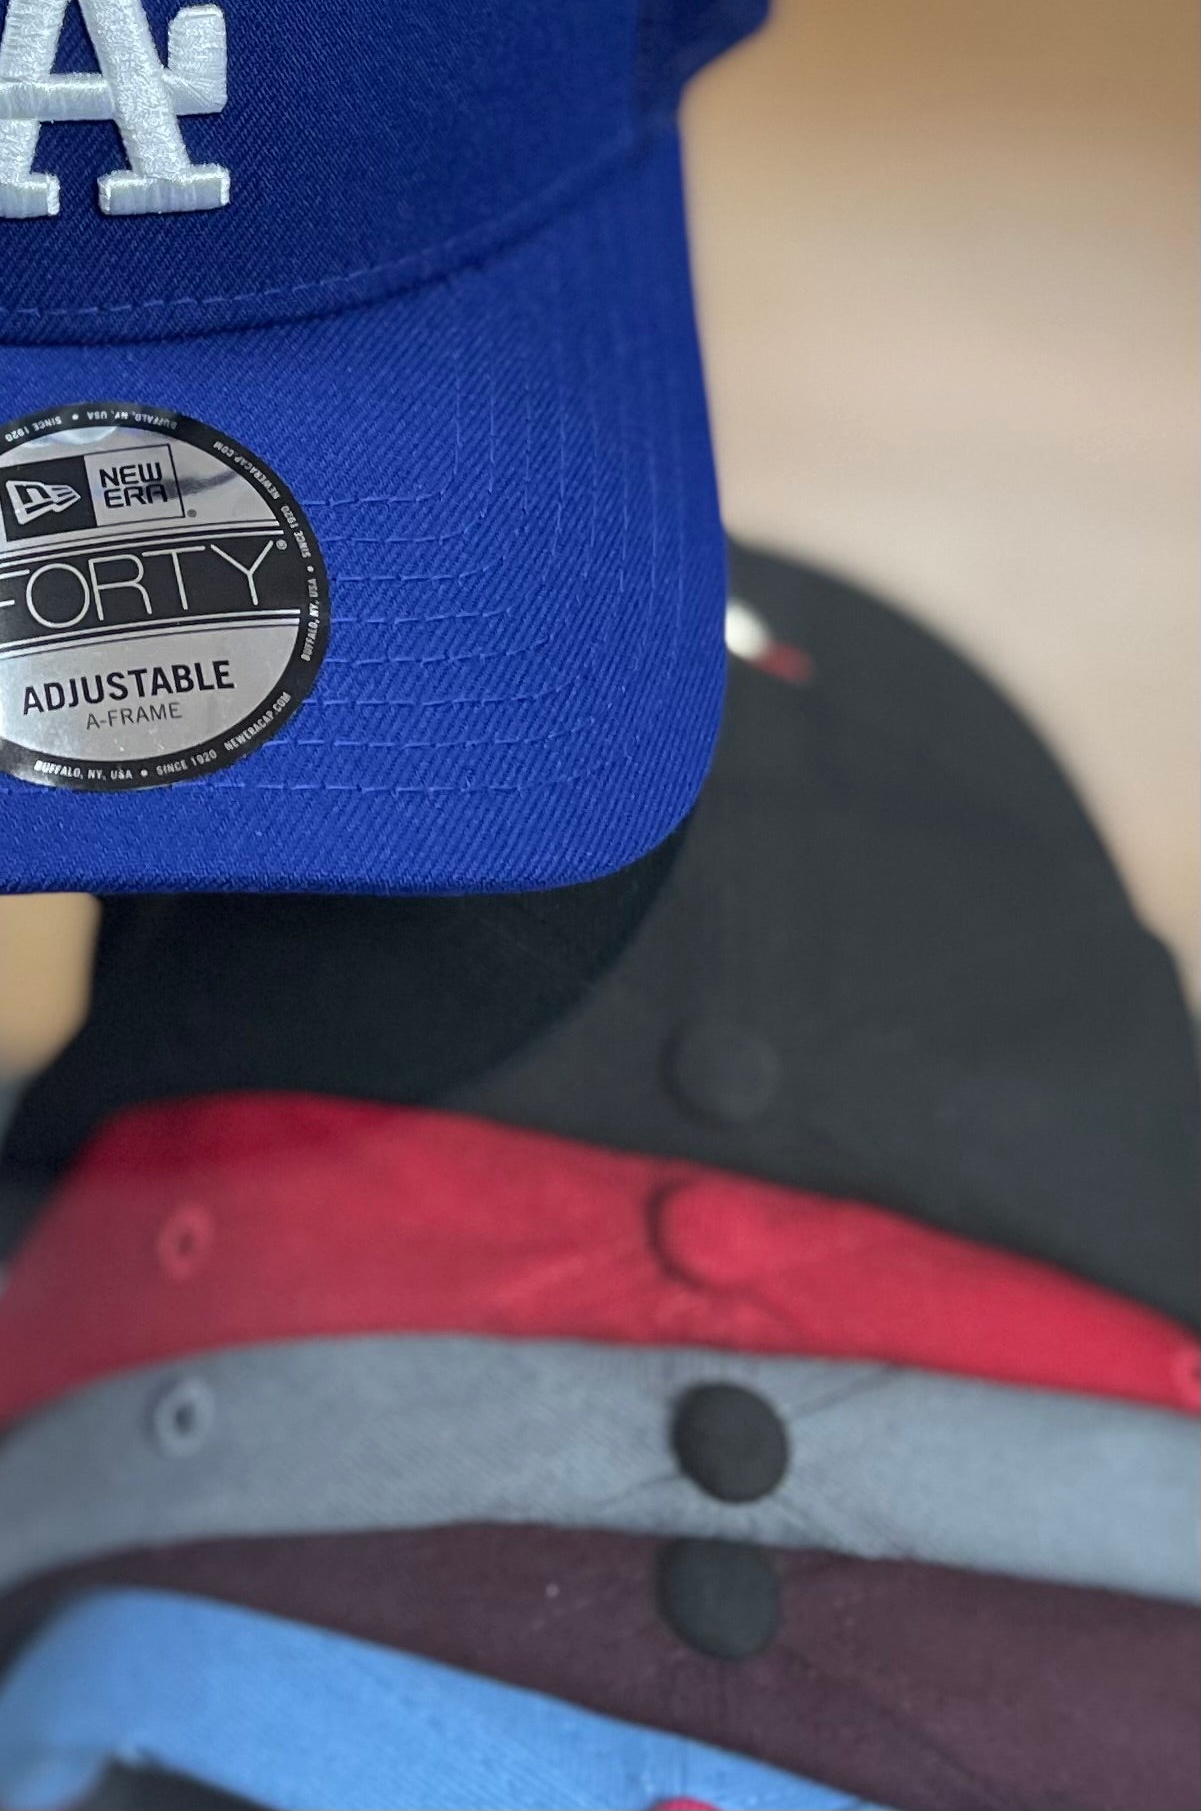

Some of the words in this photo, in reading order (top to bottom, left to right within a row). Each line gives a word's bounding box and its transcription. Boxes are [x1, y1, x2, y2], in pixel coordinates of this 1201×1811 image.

[31, 415, 63, 431] SINCE
[86, 410, 108, 420] USA
[5, 426, 30, 442] 1920
[99, 462, 162, 488] NEW
[213, 441, 280, 499] NEWERACAP.COM
[104, 484, 168, 508] ERA
[281, 505, 299, 528] 1920
[293, 530, 311, 558] SINCE
[308, 578, 319, 598] USA
[23, 660, 235, 715] ADJUSTABLE
[86, 702, 183, 730] A-FRAME
[34, 760, 84, 780] BUFFALO,
[111, 768, 133, 780] USA
[156, 759, 188, 775] SINCE
[192, 748, 217, 767] 1920
[224, 691, 291, 751] NEWERACAP.COM
